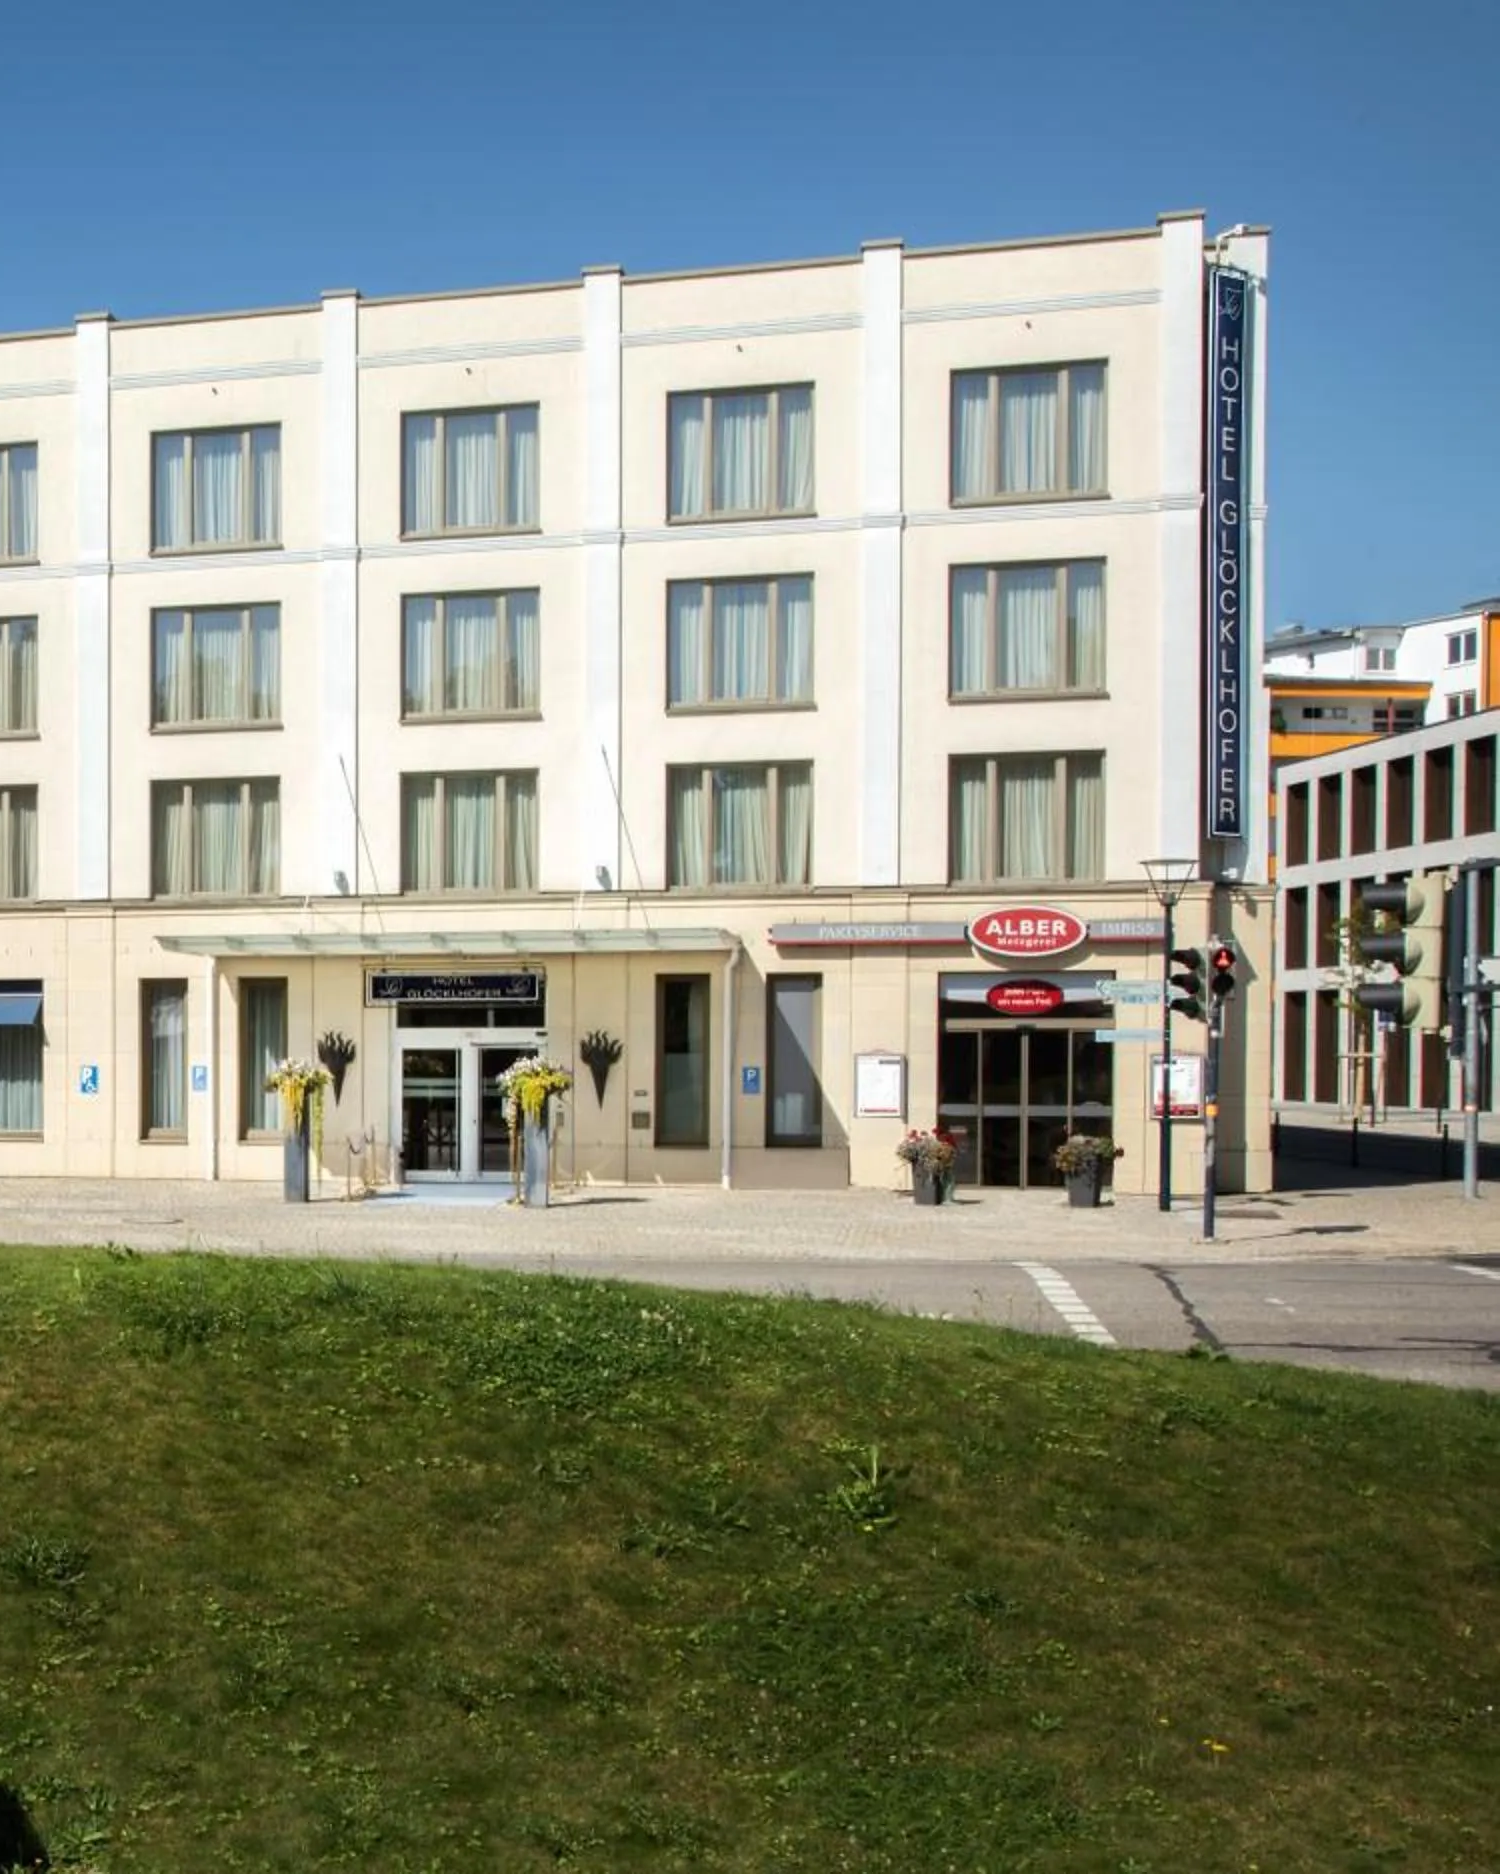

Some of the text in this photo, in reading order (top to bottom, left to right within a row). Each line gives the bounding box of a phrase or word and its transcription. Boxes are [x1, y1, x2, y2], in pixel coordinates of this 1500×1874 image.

[1218, 335, 1240, 824] HOTEL GLÖCKLHOFER
[818, 925, 919, 940] PARTYSERVICE
[985, 919, 1068, 936] ALBER
[1101, 922, 1156, 935] IMBISS
[996, 937, 1057, 948] Metzgerei
[433, 974, 474, 986] HOTEL
